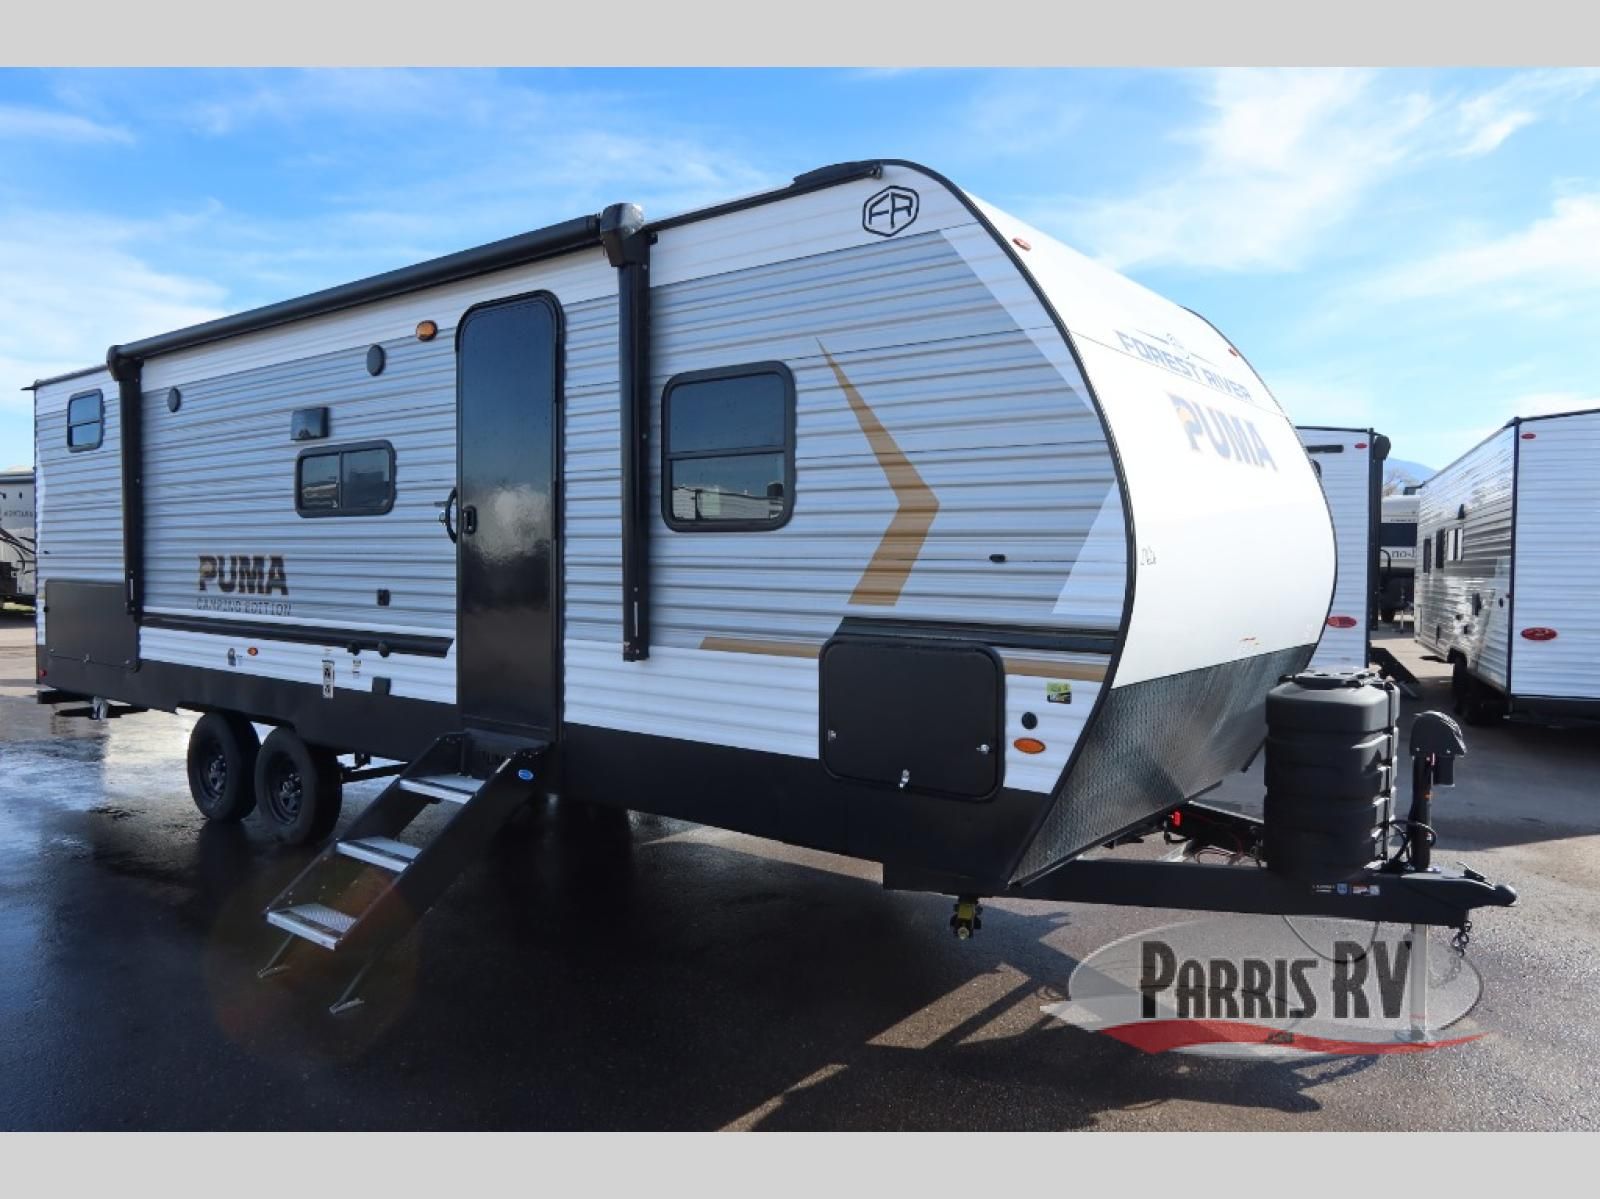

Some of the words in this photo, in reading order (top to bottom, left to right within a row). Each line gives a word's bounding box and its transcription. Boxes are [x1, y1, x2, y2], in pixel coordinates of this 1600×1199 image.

[1114, 330, 1201, 381] FOREST
[1201, 367, 1253, 401] RIVER
[1166, 392, 1279, 473] PUMA
[198, 555, 289, 596] PUMA
[196, 598, 242, 613] CAMPING
[244, 602, 292, 617] EDITION
